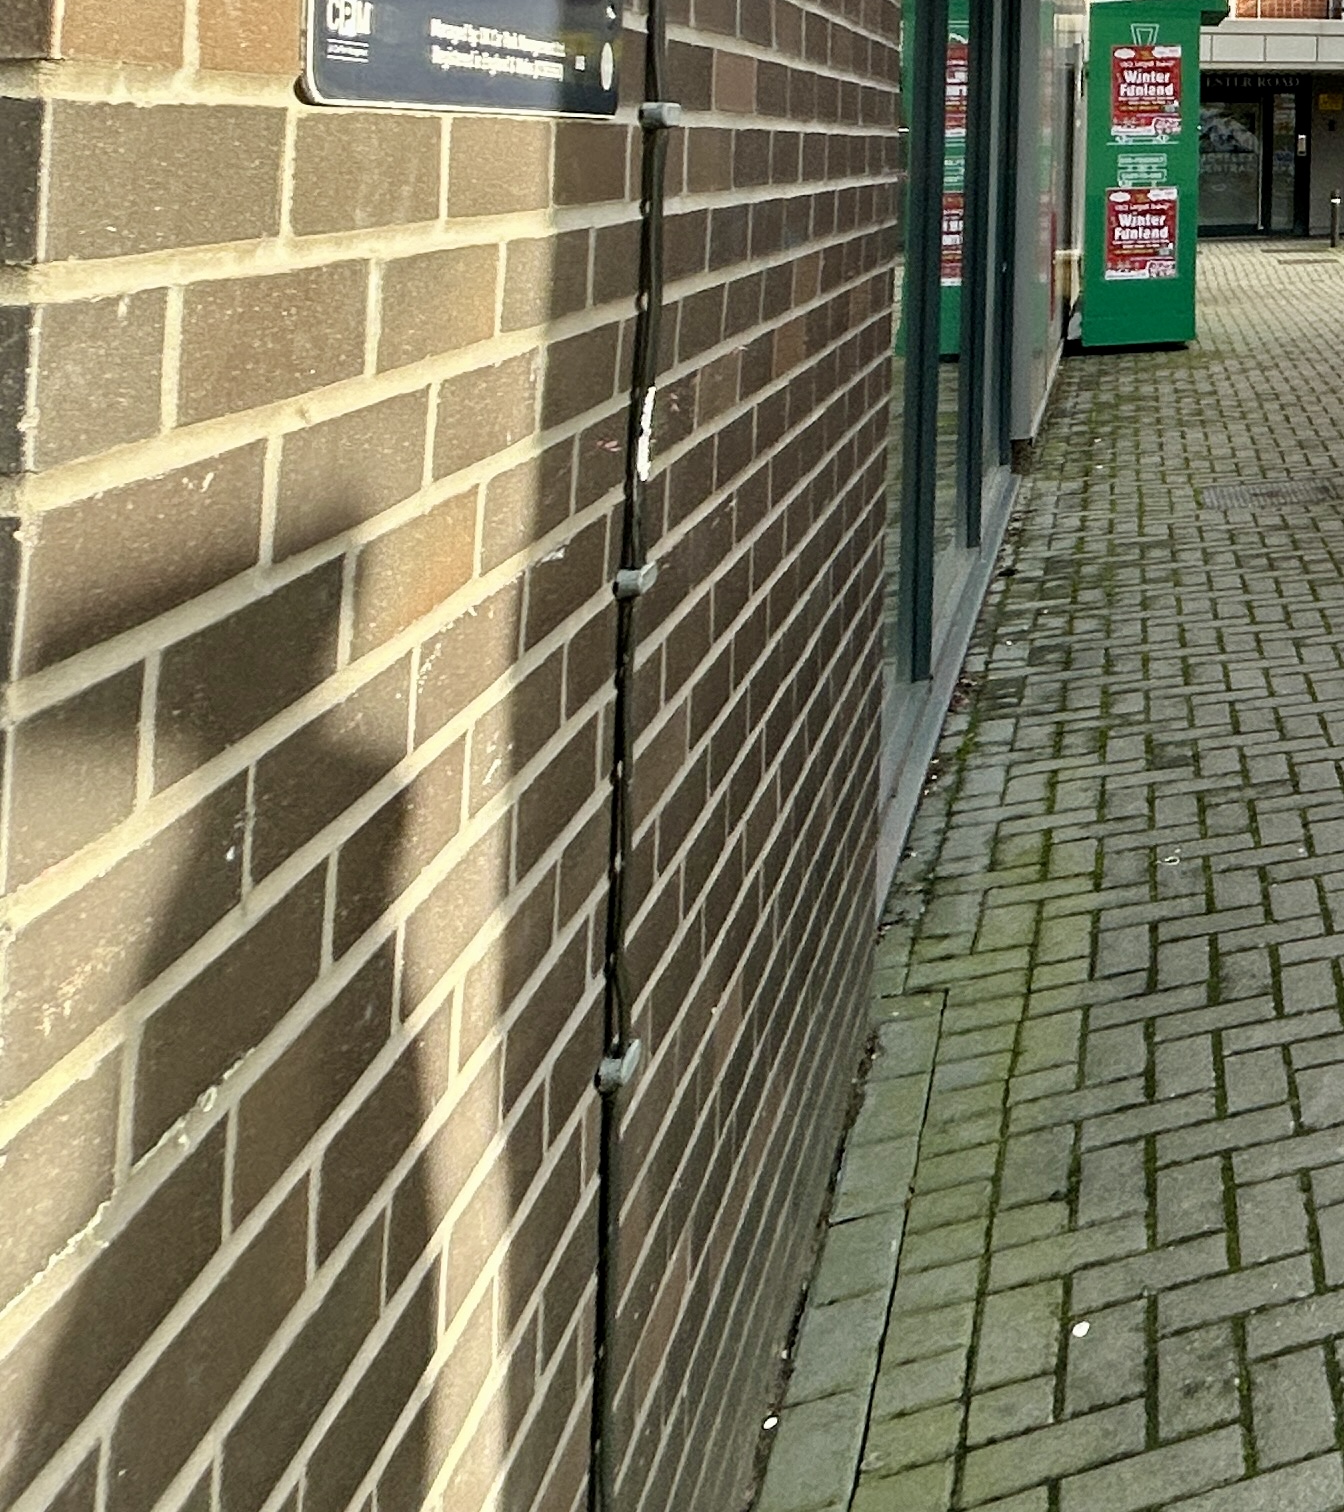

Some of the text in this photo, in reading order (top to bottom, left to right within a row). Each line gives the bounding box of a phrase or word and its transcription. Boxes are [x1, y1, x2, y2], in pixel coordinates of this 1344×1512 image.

[1123, 69, 1171, 84] Winter
[1120, 83, 1174, 97] Funland
[1118, 212, 1166, 228] Winter
[1114, 226, 1169, 241] Funland
